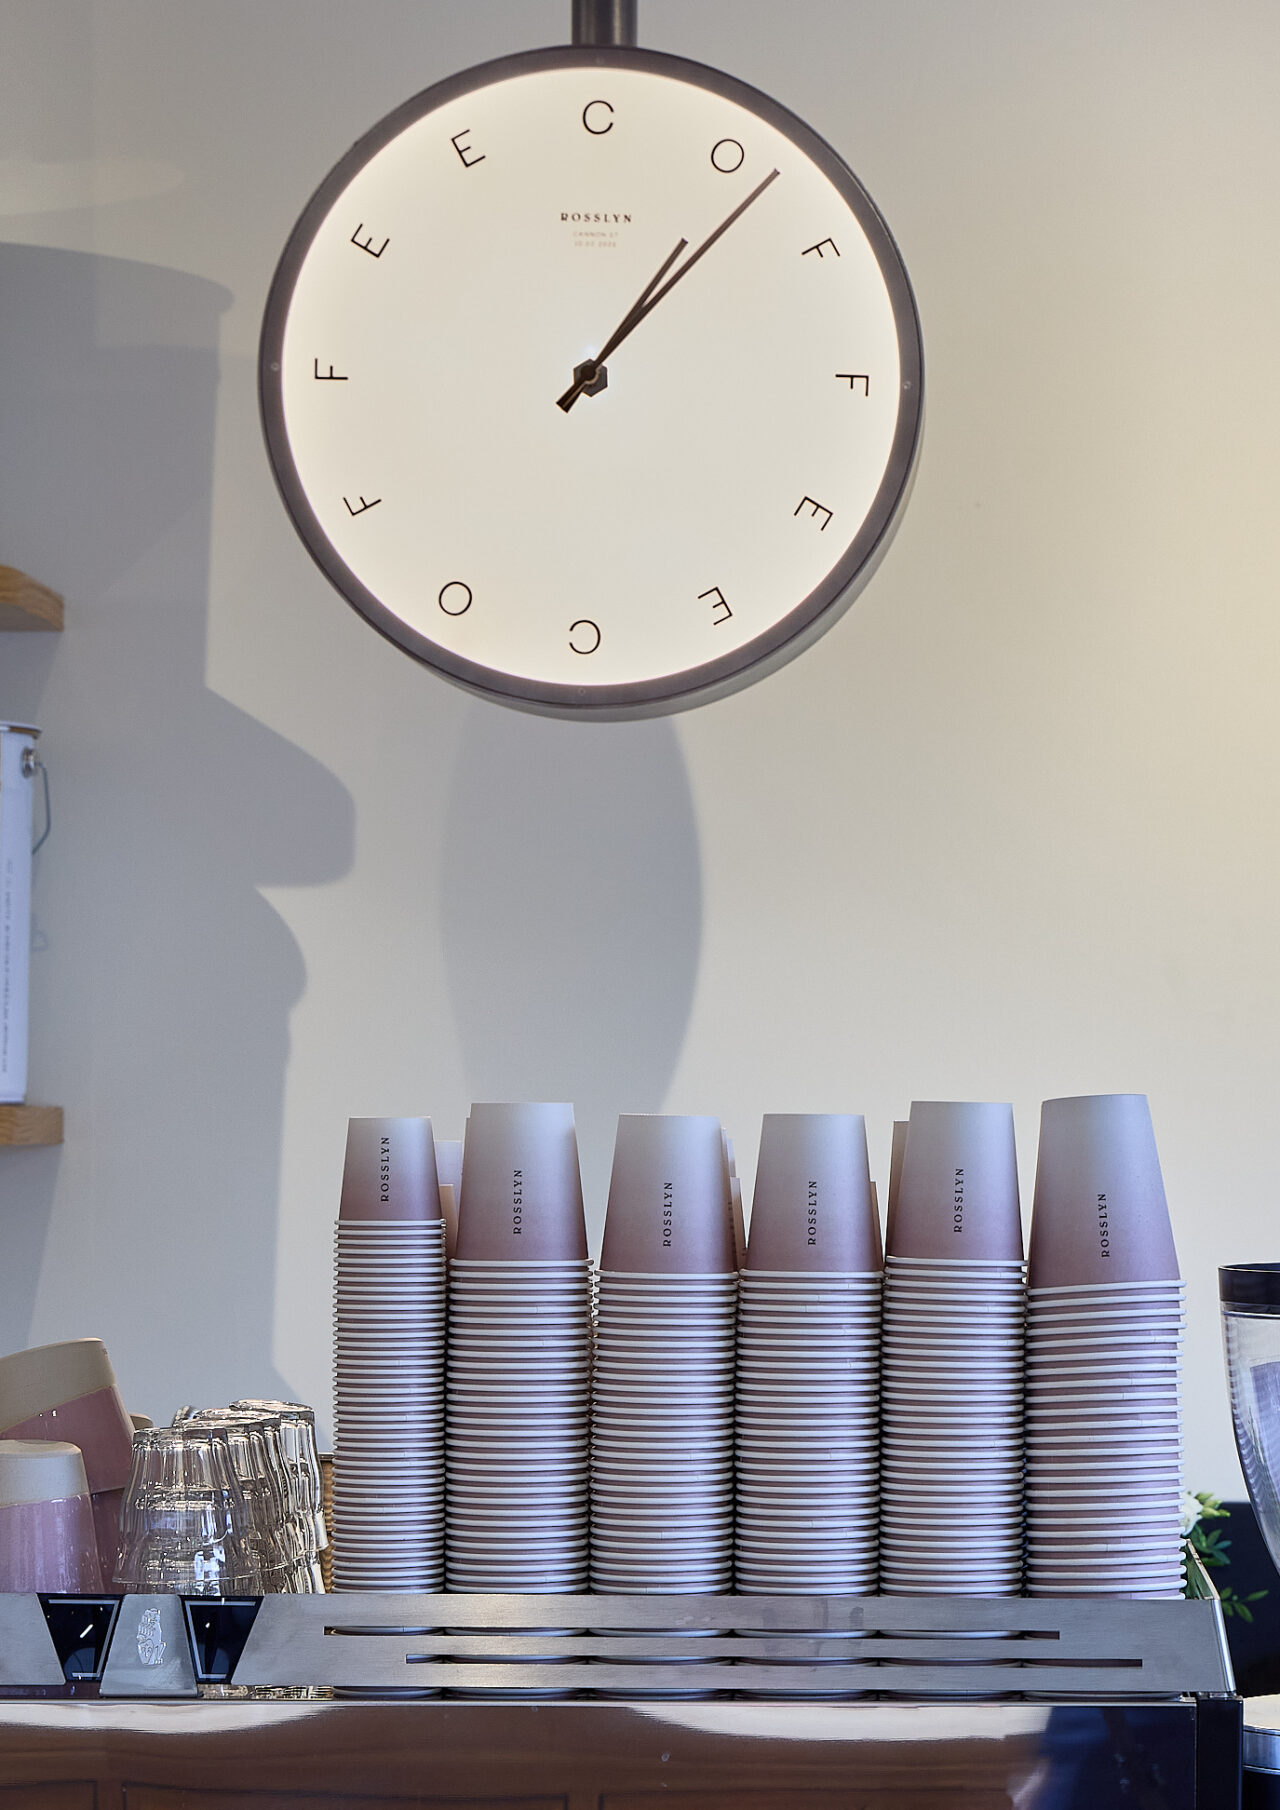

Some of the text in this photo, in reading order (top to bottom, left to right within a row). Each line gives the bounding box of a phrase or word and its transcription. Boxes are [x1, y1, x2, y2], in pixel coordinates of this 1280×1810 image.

[560, 212, 632, 223] ROSSLYN
[380, 1136, 390, 1202] ROSSLYN
[513, 1169, 523, 1235] ROSSLYN
[954, 1167, 964, 1233] ROSSLYN
[662, 1181, 673, 1247] ROSSLYN
[808, 1180, 817, 1246] ROSSLYN
[1099, 1193, 1109, 1258] ROSSLYN
